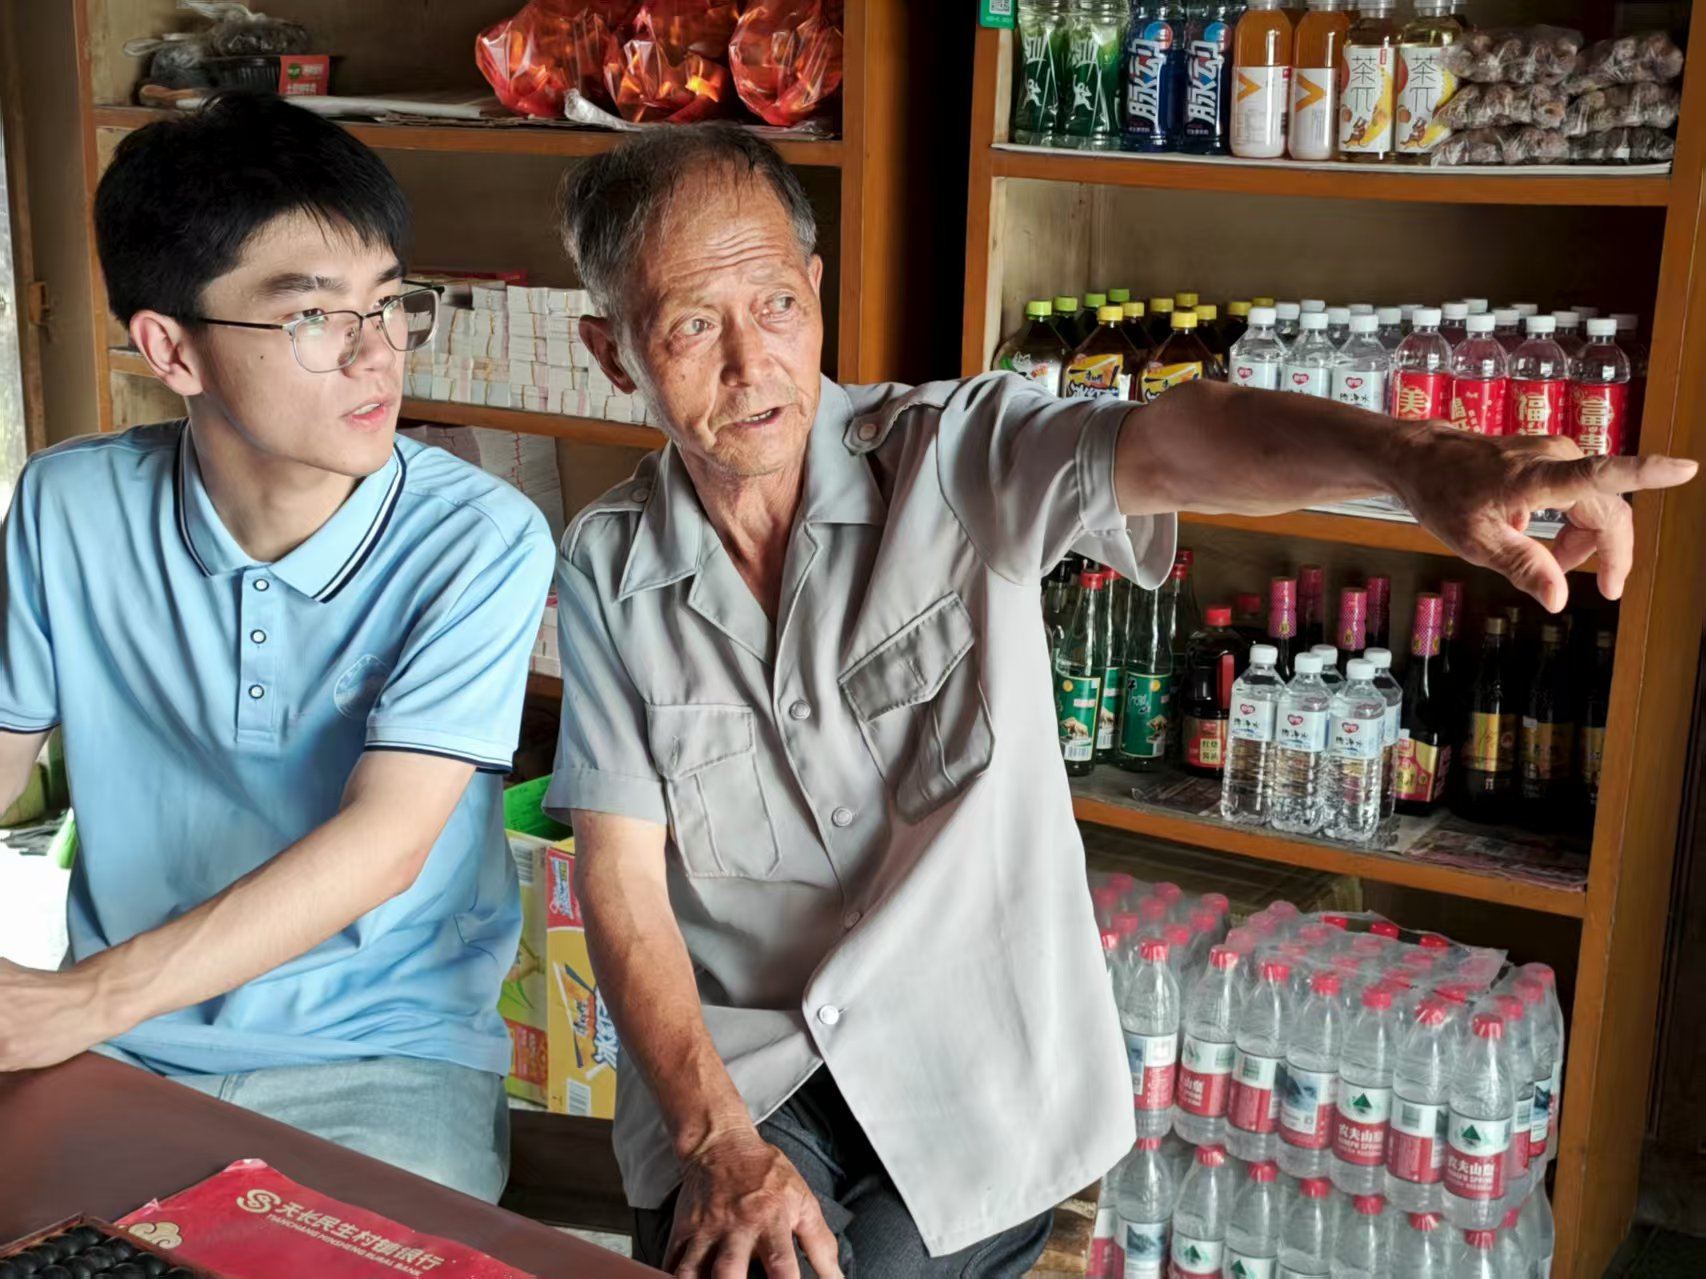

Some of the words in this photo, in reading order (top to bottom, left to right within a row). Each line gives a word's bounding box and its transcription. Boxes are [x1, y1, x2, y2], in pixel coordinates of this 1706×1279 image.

[1128, 38, 1165, 123] 脉动
[1186, 40, 1223, 125] 脉动
[274, 1201, 445, 1270] 天长民生村镇银行
